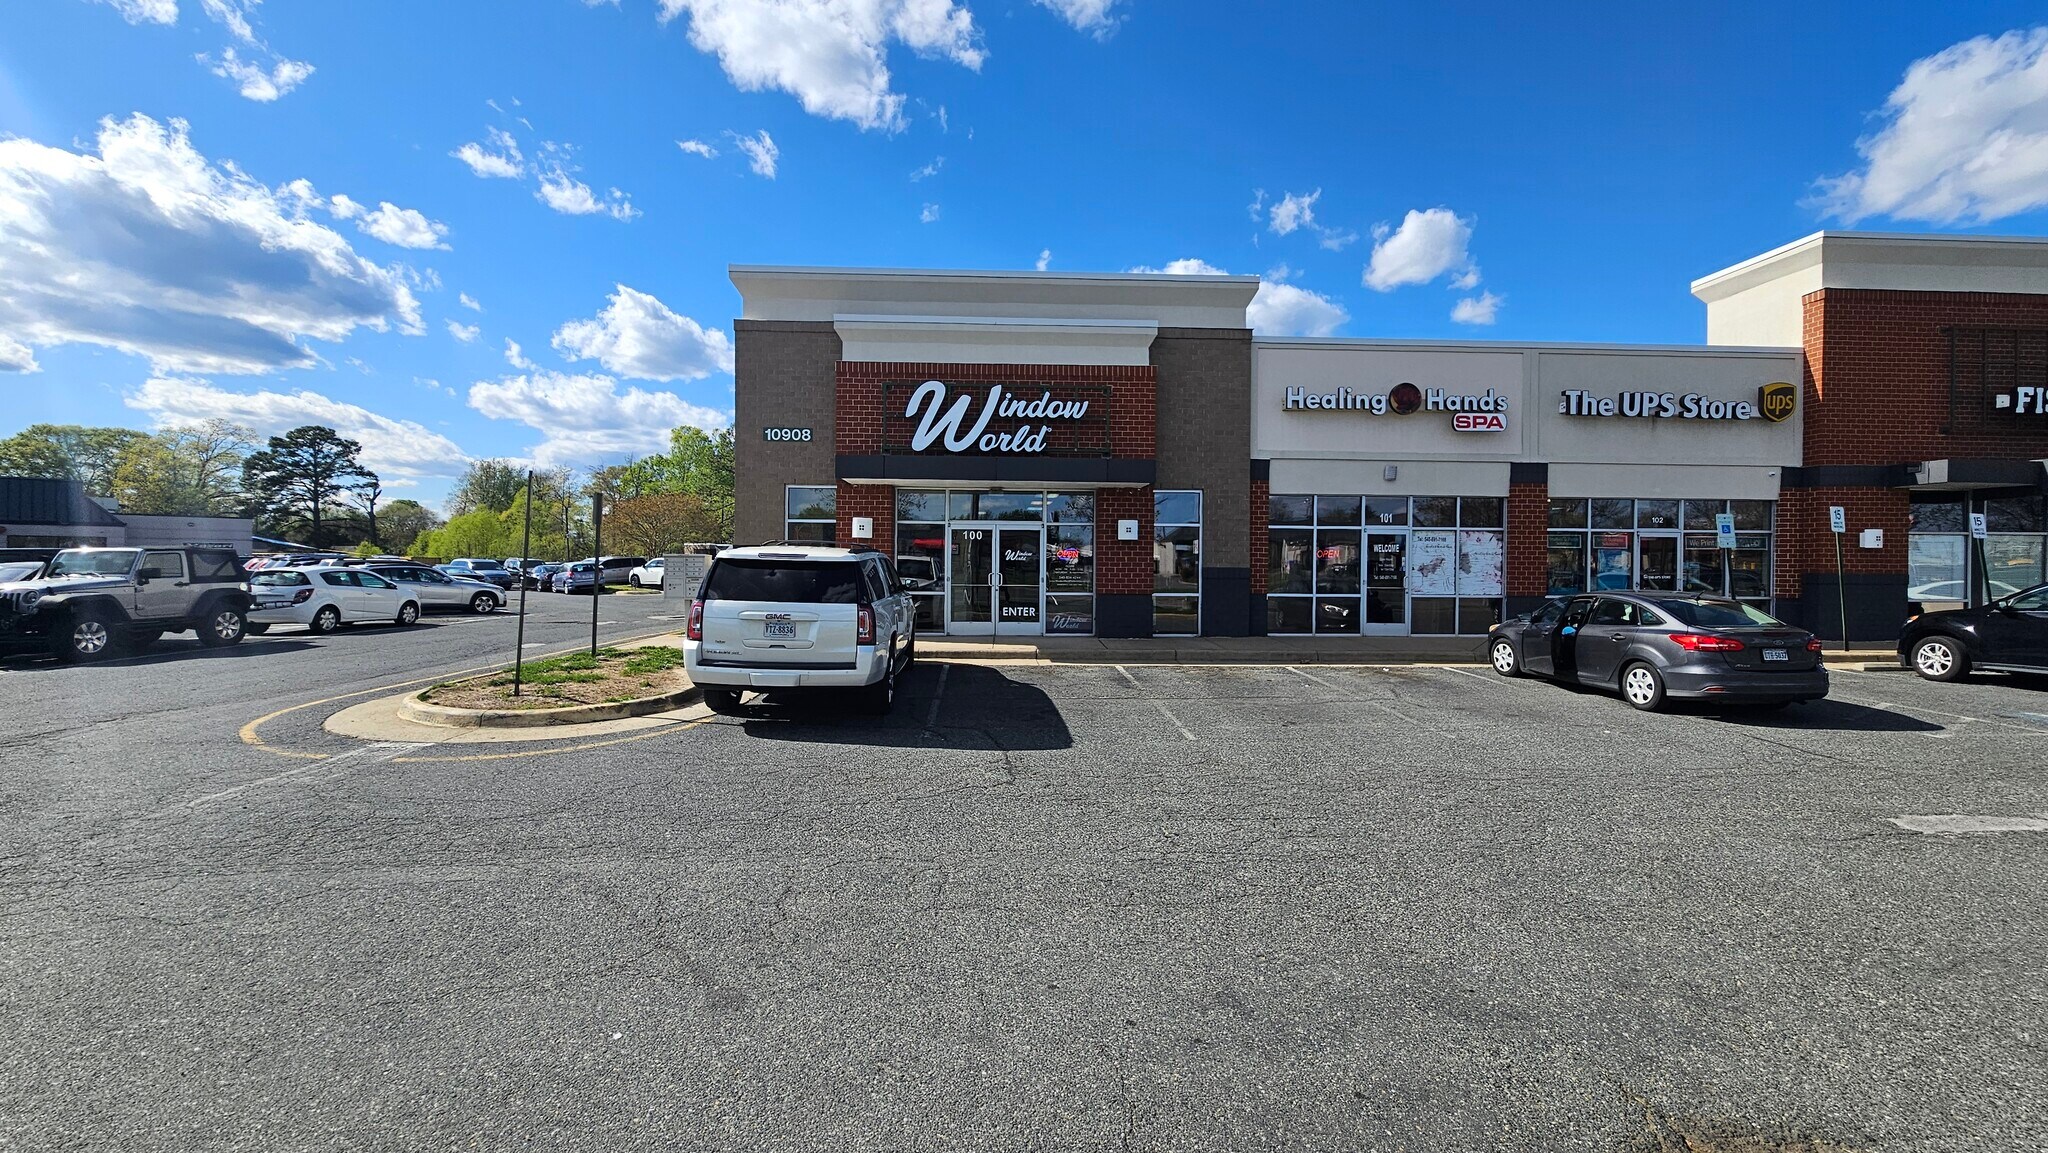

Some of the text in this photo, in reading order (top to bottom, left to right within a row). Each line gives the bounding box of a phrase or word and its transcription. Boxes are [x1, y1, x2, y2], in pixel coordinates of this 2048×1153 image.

[1285, 386, 1508, 415] Healing Hands
[1564, 390, 1752, 420] The UPS Store
[1766, 395, 1793, 415] ups
[2015, 386, 2048, 413] FI
[906, 380, 1089, 452] Window
[1455, 415, 1504, 429] SPA
[764, 428, 811, 442] 10908
[1380, 513, 1393, 523] 101
[1833, 509, 1842, 520] 15
[1973, 516, 1982, 526] 15
[962, 530, 983, 540] 100
[1316, 549, 1340, 559] OPEN
[1373, 544, 1400, 553] WELCOME
[1057, 550, 1079, 559] OPEN
[1002, 606, 1036, 617] ENTER
